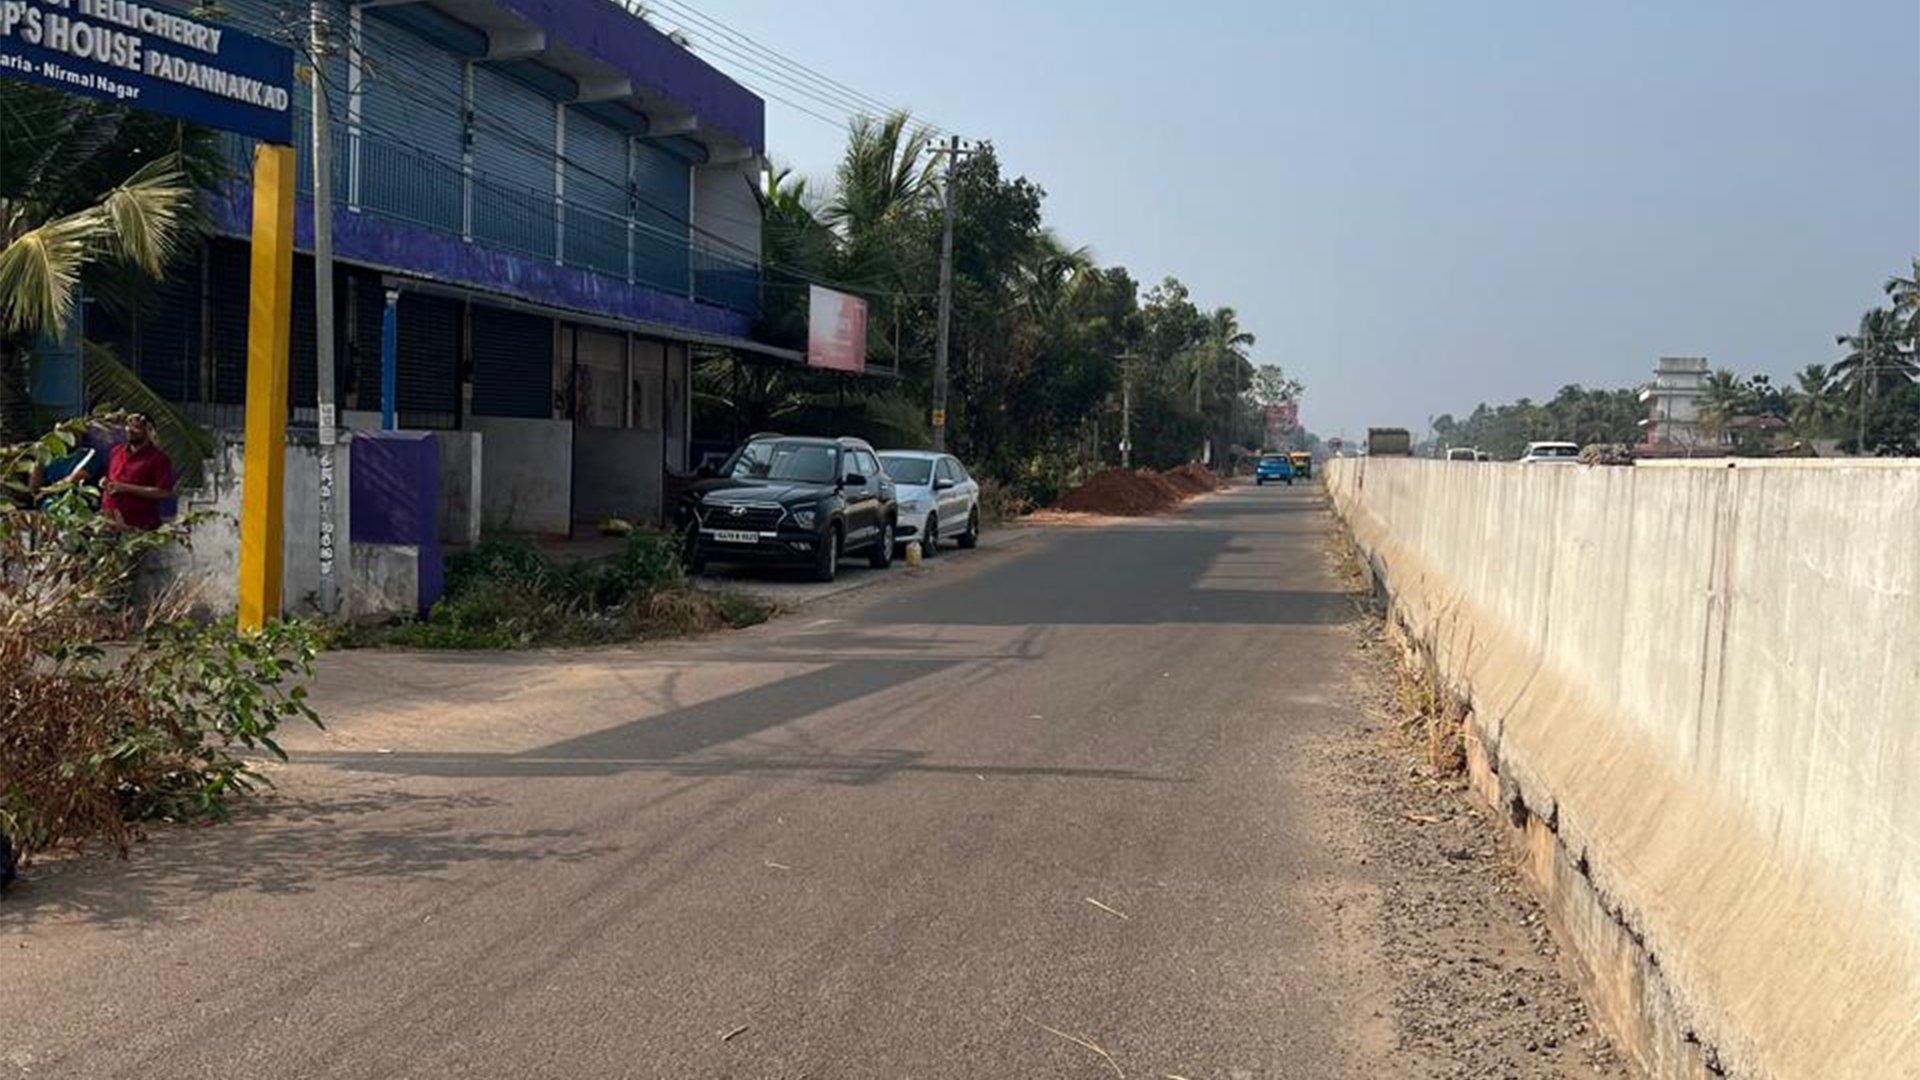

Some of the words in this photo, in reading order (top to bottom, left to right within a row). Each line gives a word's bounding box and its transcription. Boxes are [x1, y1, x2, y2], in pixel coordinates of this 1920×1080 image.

[43, 62, 95, 88] Nirmal
[97, 76, 140, 99] Nagar
[44, 13, 141, 71] HOUSE
[144, 51, 289, 111] PADANNAKKAD
